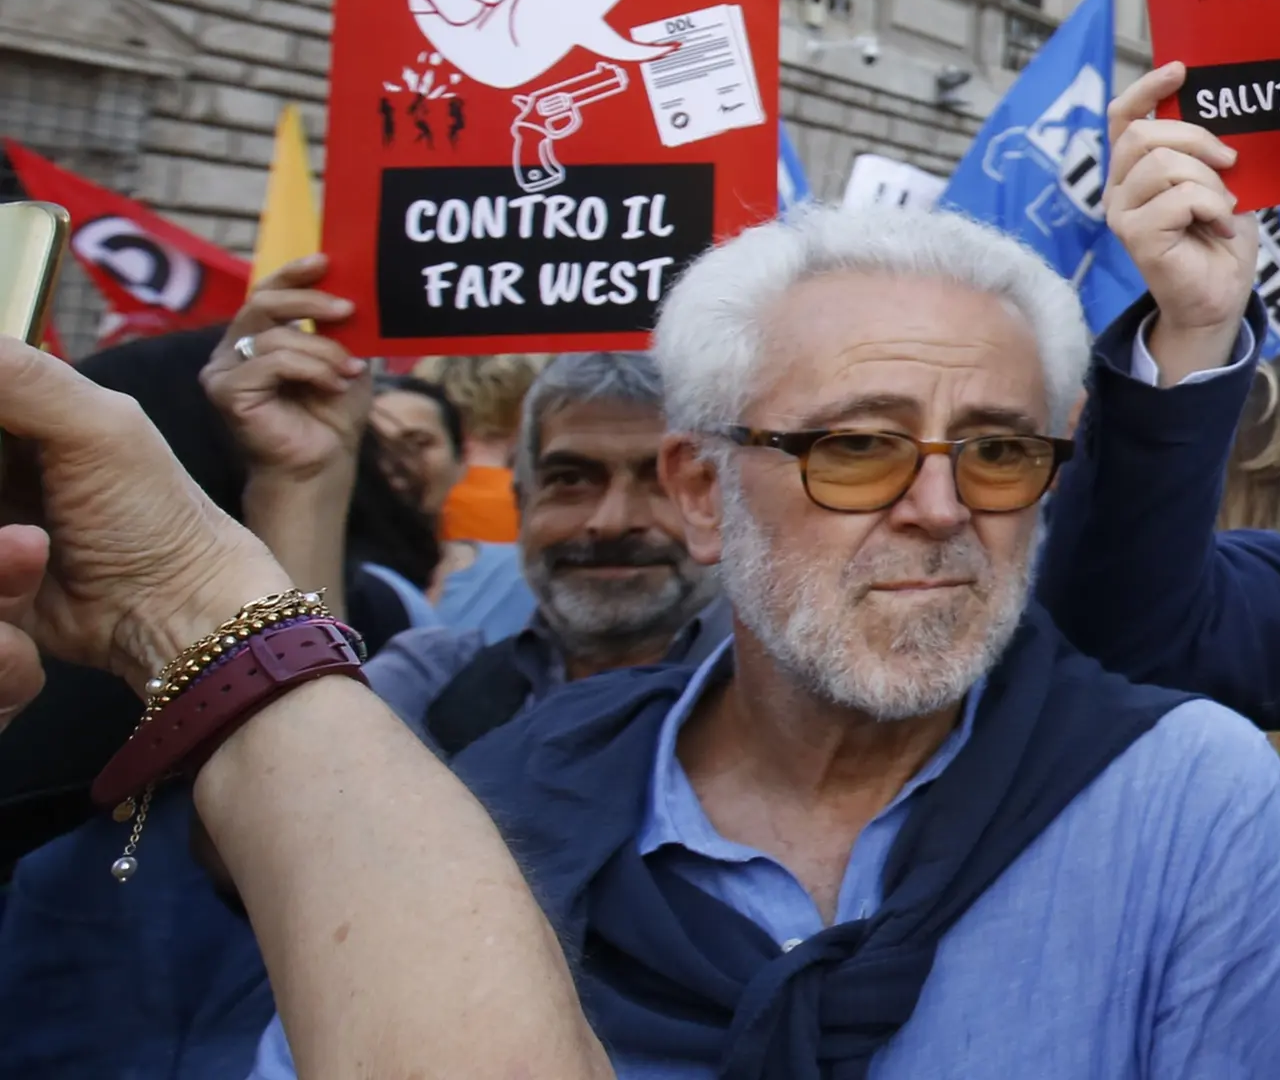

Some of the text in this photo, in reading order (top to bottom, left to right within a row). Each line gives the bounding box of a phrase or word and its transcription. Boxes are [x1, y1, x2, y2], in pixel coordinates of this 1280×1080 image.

[667, 16, 695, 34] DDL
[406, 194, 673, 243] CONTRO IL
[422, 257, 673, 309] FAR WEST
